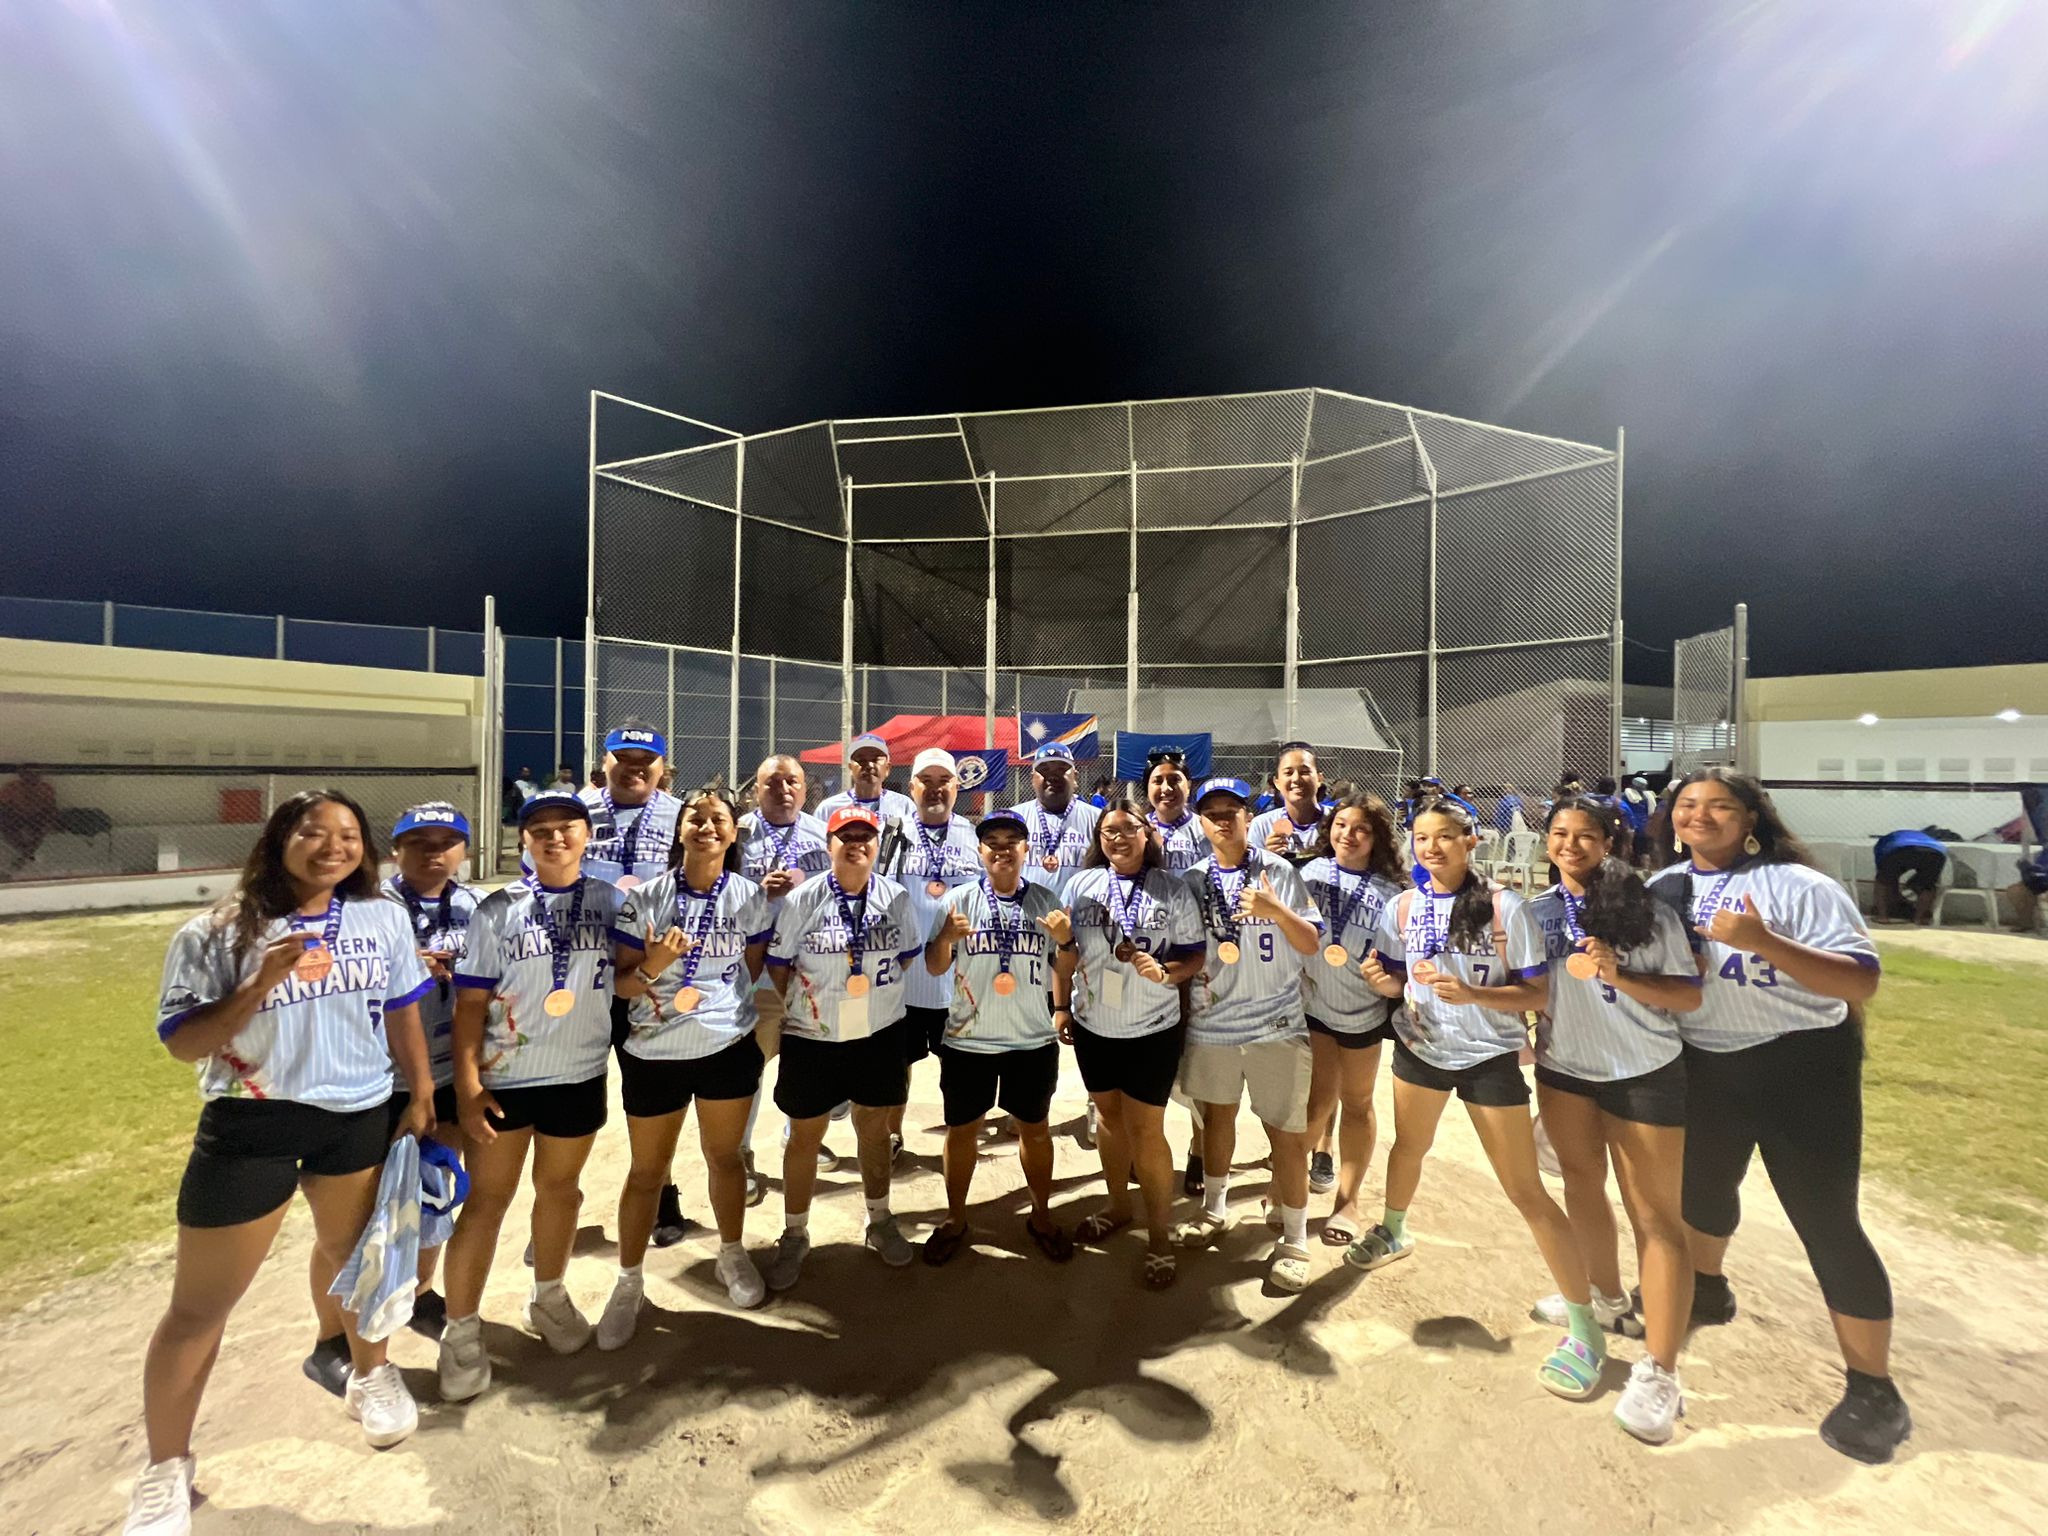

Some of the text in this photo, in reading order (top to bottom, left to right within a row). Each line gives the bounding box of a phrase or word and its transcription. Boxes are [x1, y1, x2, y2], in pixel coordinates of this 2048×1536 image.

[621, 730, 654, 743] NMI
[414, 810, 454, 823] NMI
[839, 808, 872, 821] RMI
[1027, 832, 1085, 844] ORERN
[524, 909, 602, 928] NOTHRN
[502, 924, 608, 961] MARANA
[965, 930, 1046, 957] MARNAS
[1259, 933, 1274, 963] 9
[1473, 963, 1490, 987] 7
[1718, 953, 1778, 988] 43
[256, 957, 391, 1013] ARIANAS
